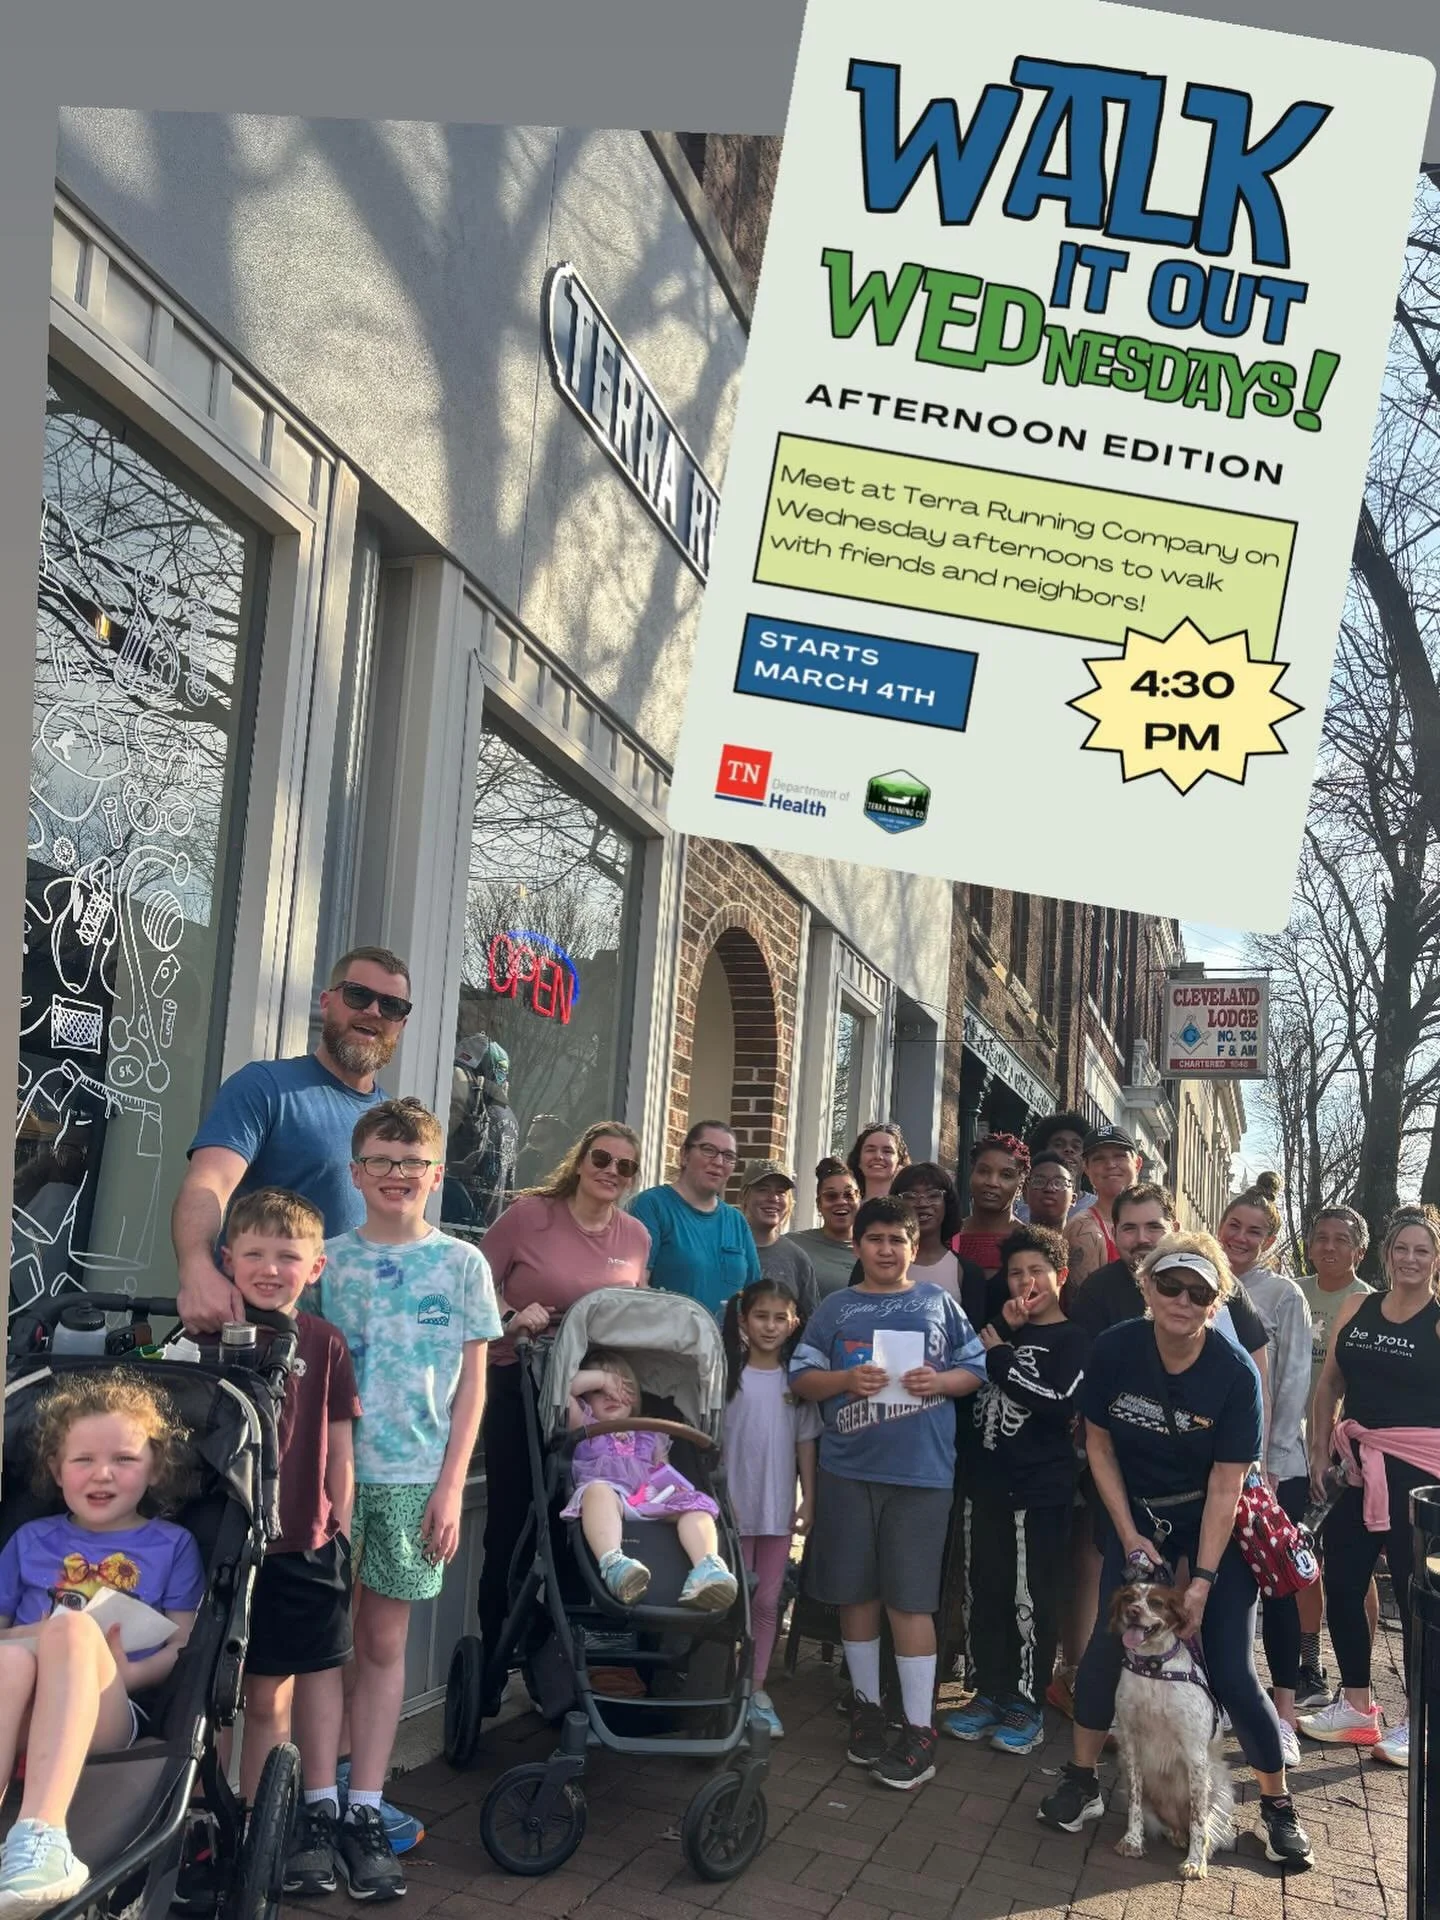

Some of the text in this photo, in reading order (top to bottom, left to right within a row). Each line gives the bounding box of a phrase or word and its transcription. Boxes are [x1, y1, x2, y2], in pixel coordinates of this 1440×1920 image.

[563, 276, 677, 529] TERRA
[488, 933, 574, 1025] OPEN
[1173, 987, 1260, 1006] CLEVELAND
[1207, 1008, 1259, 1028] LODGE
[1217, 1030, 1257, 1043] NO. 134
[1217, 1045, 1258, 1057] F & AM
[1179, 1060, 1226, 1068] CHARTERED
[1349, 1326, 1416, 1350] be you.
[836, 1399, 880, 1433] GREEN
